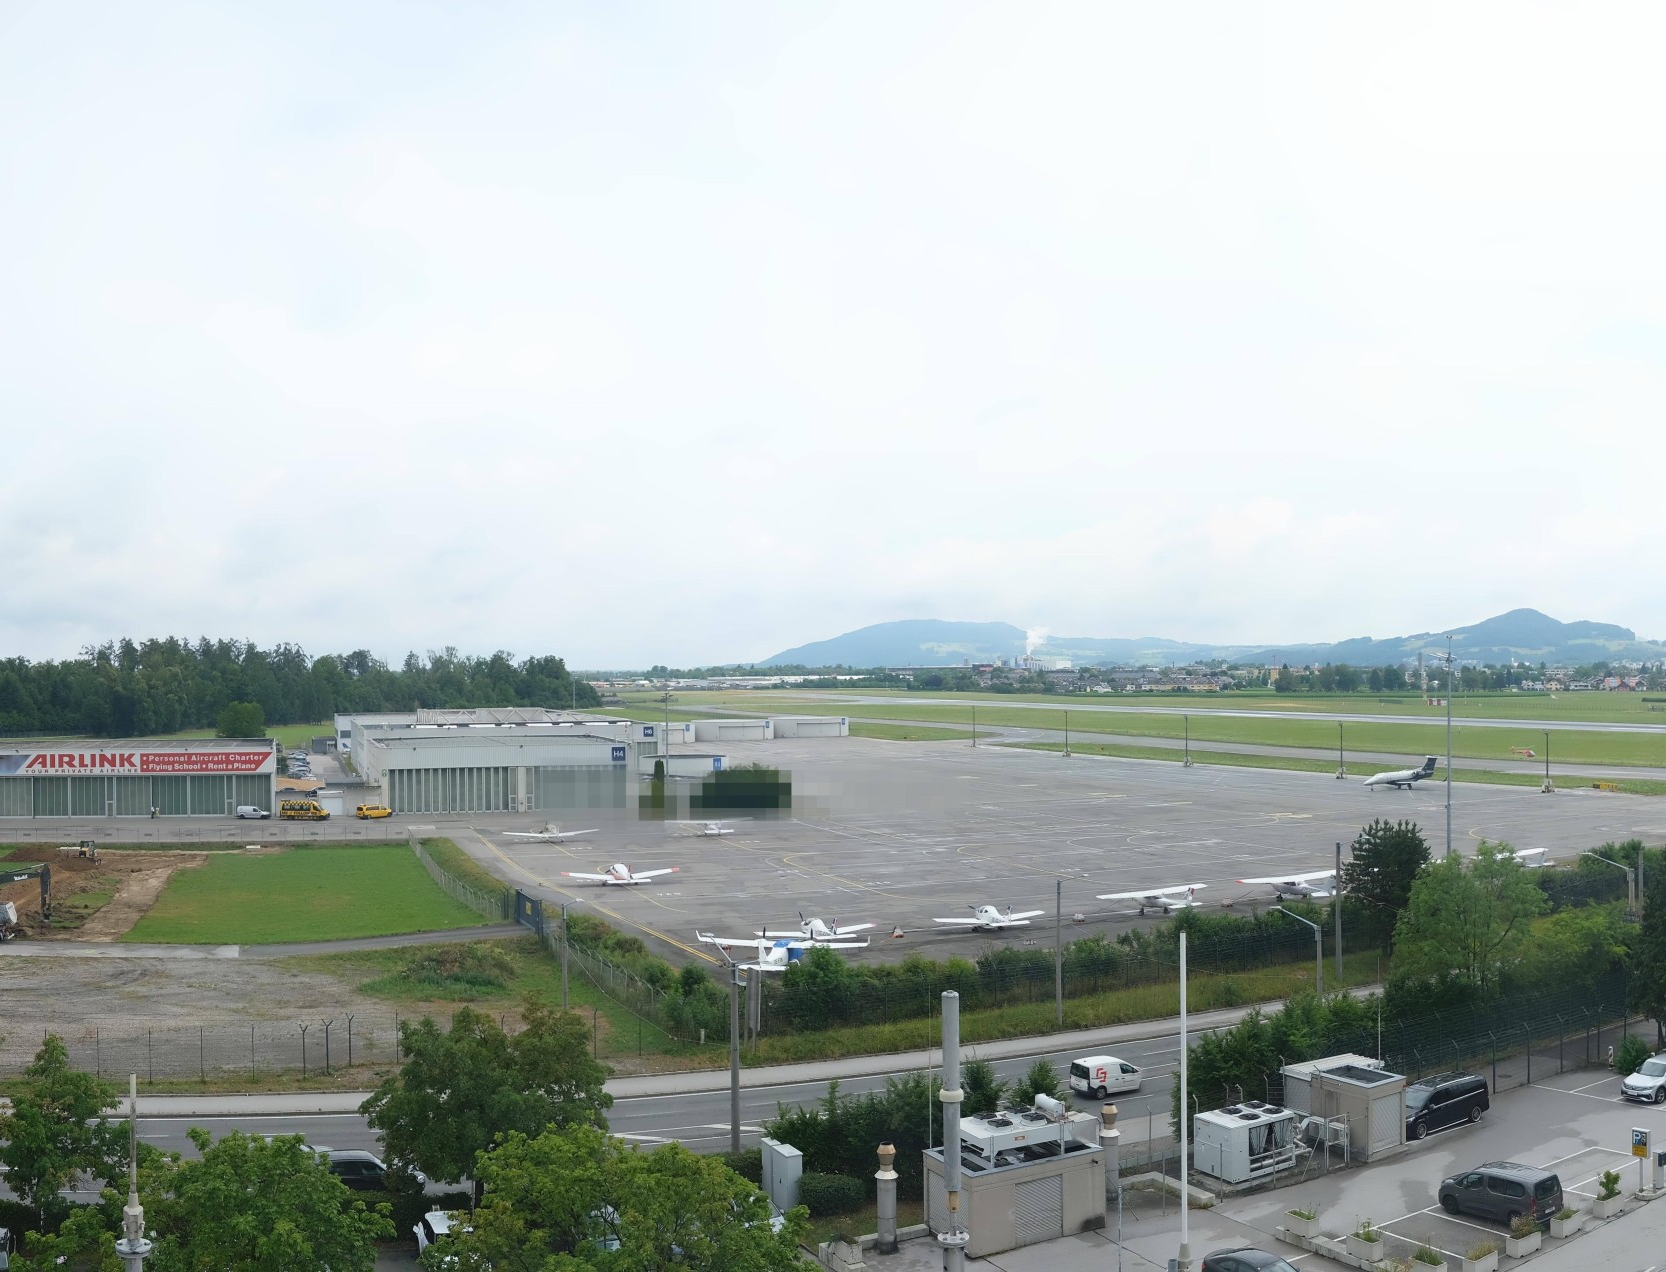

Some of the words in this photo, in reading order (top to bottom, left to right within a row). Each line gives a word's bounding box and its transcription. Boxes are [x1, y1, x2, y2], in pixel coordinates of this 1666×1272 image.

[613, 750, 623, 758] H4
[25, 753, 138, 768] AIRLINK
[149, 763, 172, 771] Flying
